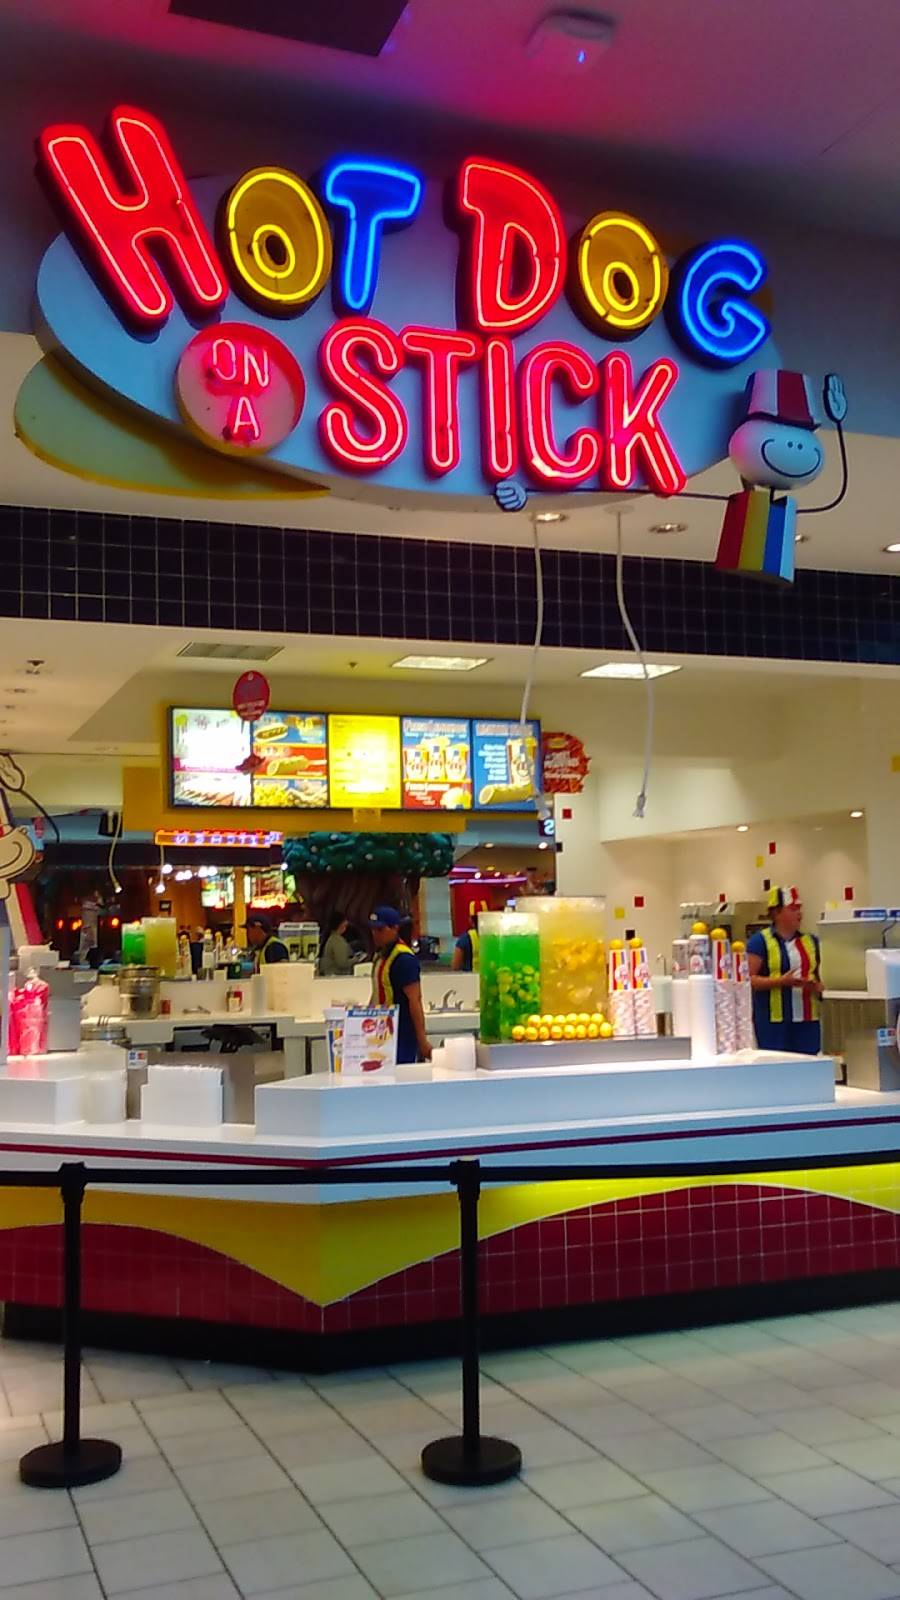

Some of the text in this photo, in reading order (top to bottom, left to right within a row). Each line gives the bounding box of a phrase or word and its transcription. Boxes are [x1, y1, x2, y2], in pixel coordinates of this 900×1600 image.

[40, 105, 770, 362] HOT DOG
[212, 338, 270, 388] ON
[233, 396, 260, 438] A
[319, 316, 688, 495] STICK
